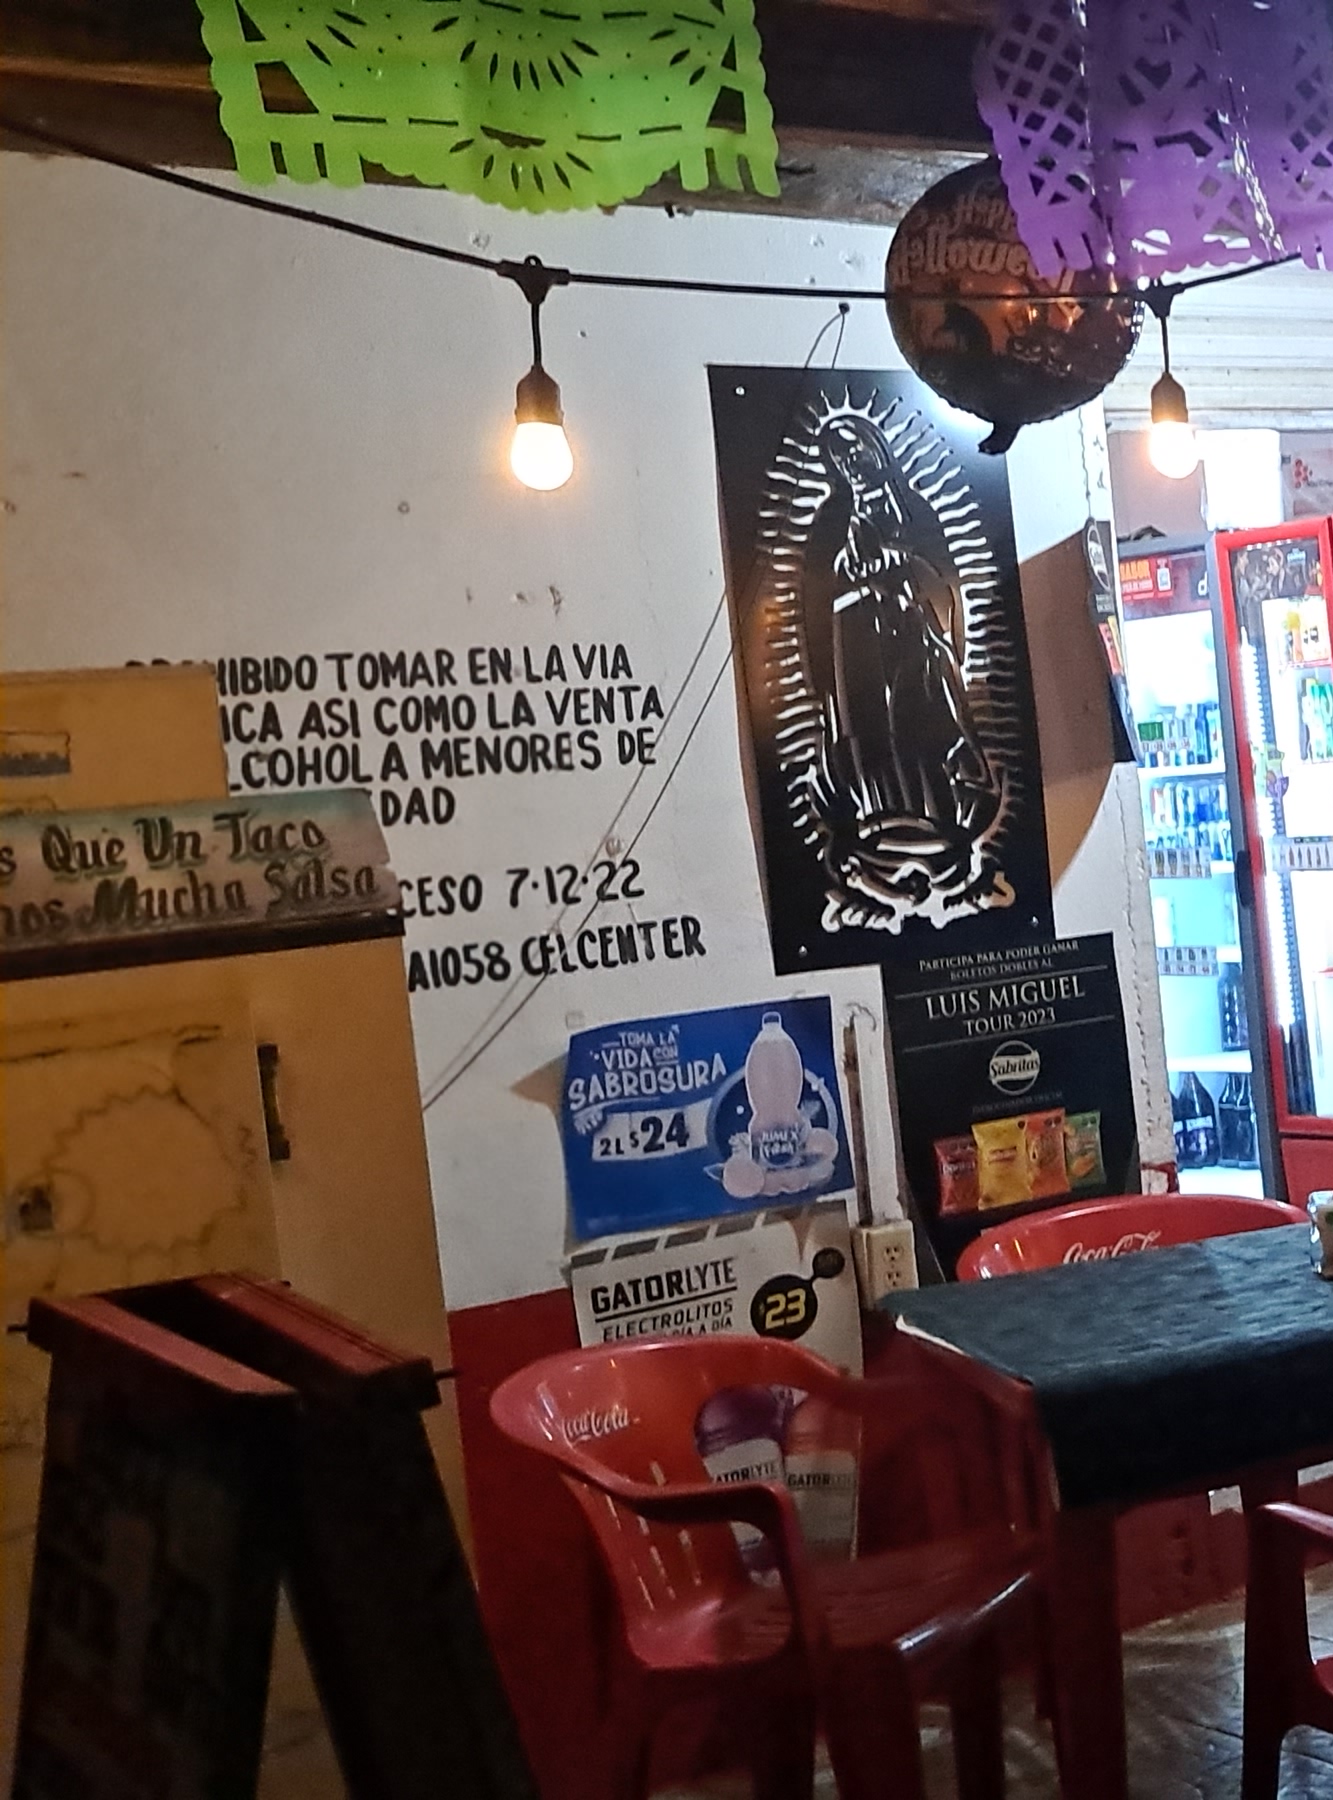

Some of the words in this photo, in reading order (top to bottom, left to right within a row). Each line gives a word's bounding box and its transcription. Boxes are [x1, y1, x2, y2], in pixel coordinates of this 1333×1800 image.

[324, 648, 458, 692] TOMAR
[467, 646, 513, 685] EN
[523, 645, 568, 683] LA
[572, 643, 634, 681] VIA
[220, 700, 283, 744] ICA
[297, 697, 361, 741] ASI
[373, 693, 477, 737] COMO
[487, 689, 537, 730] LA
[545, 685, 665, 726] VENTA
[230, 743, 372, 792] COHOL
[380, 741, 409, 783] A
[420, 730, 603, 780] MENORES
[617, 726, 657, 766] DE
[380, 786, 456, 827] DAD
[41, 824, 128, 877] Que
[133, 816, 204, 868] Un
[212, 810, 332, 861] Taco
[80, 869, 248, 930] Mucha
[264, 855, 380, 903] Salsa
[399, 873, 483, 918] CESO
[521, 915, 707, 977] CELCENTER
[918, 954, 974, 973] PARTICIPA
[976, 950, 1002, 964] PARA
[1005, 946, 1041, 960] PODER
[1042, 940, 1080, 956] GANAR
[950, 964, 998, 981] BOLETOS
[926, 988, 981, 1020] LUIS
[988, 975, 1086, 1012] MIGUEL
[618, 1031, 655, 1048] TOMA
[659, 1031, 676, 1046] LA
[963, 1014, 1016, 1036] TOUR
[1020, 1007, 1057, 1031] 2023
[600, 1047, 654, 1071] VIDA
[652, 1045, 679, 1060] CON
[990, 1054, 1041, 1079] Sabritas
[568, 1052, 727, 1112] SABROSURA
[590, 1256, 738, 1315] GATORLYTE
[603, 1298, 733, 1343] ELECTROLITOS
[715, 1461, 777, 1484] ATORLYTE
